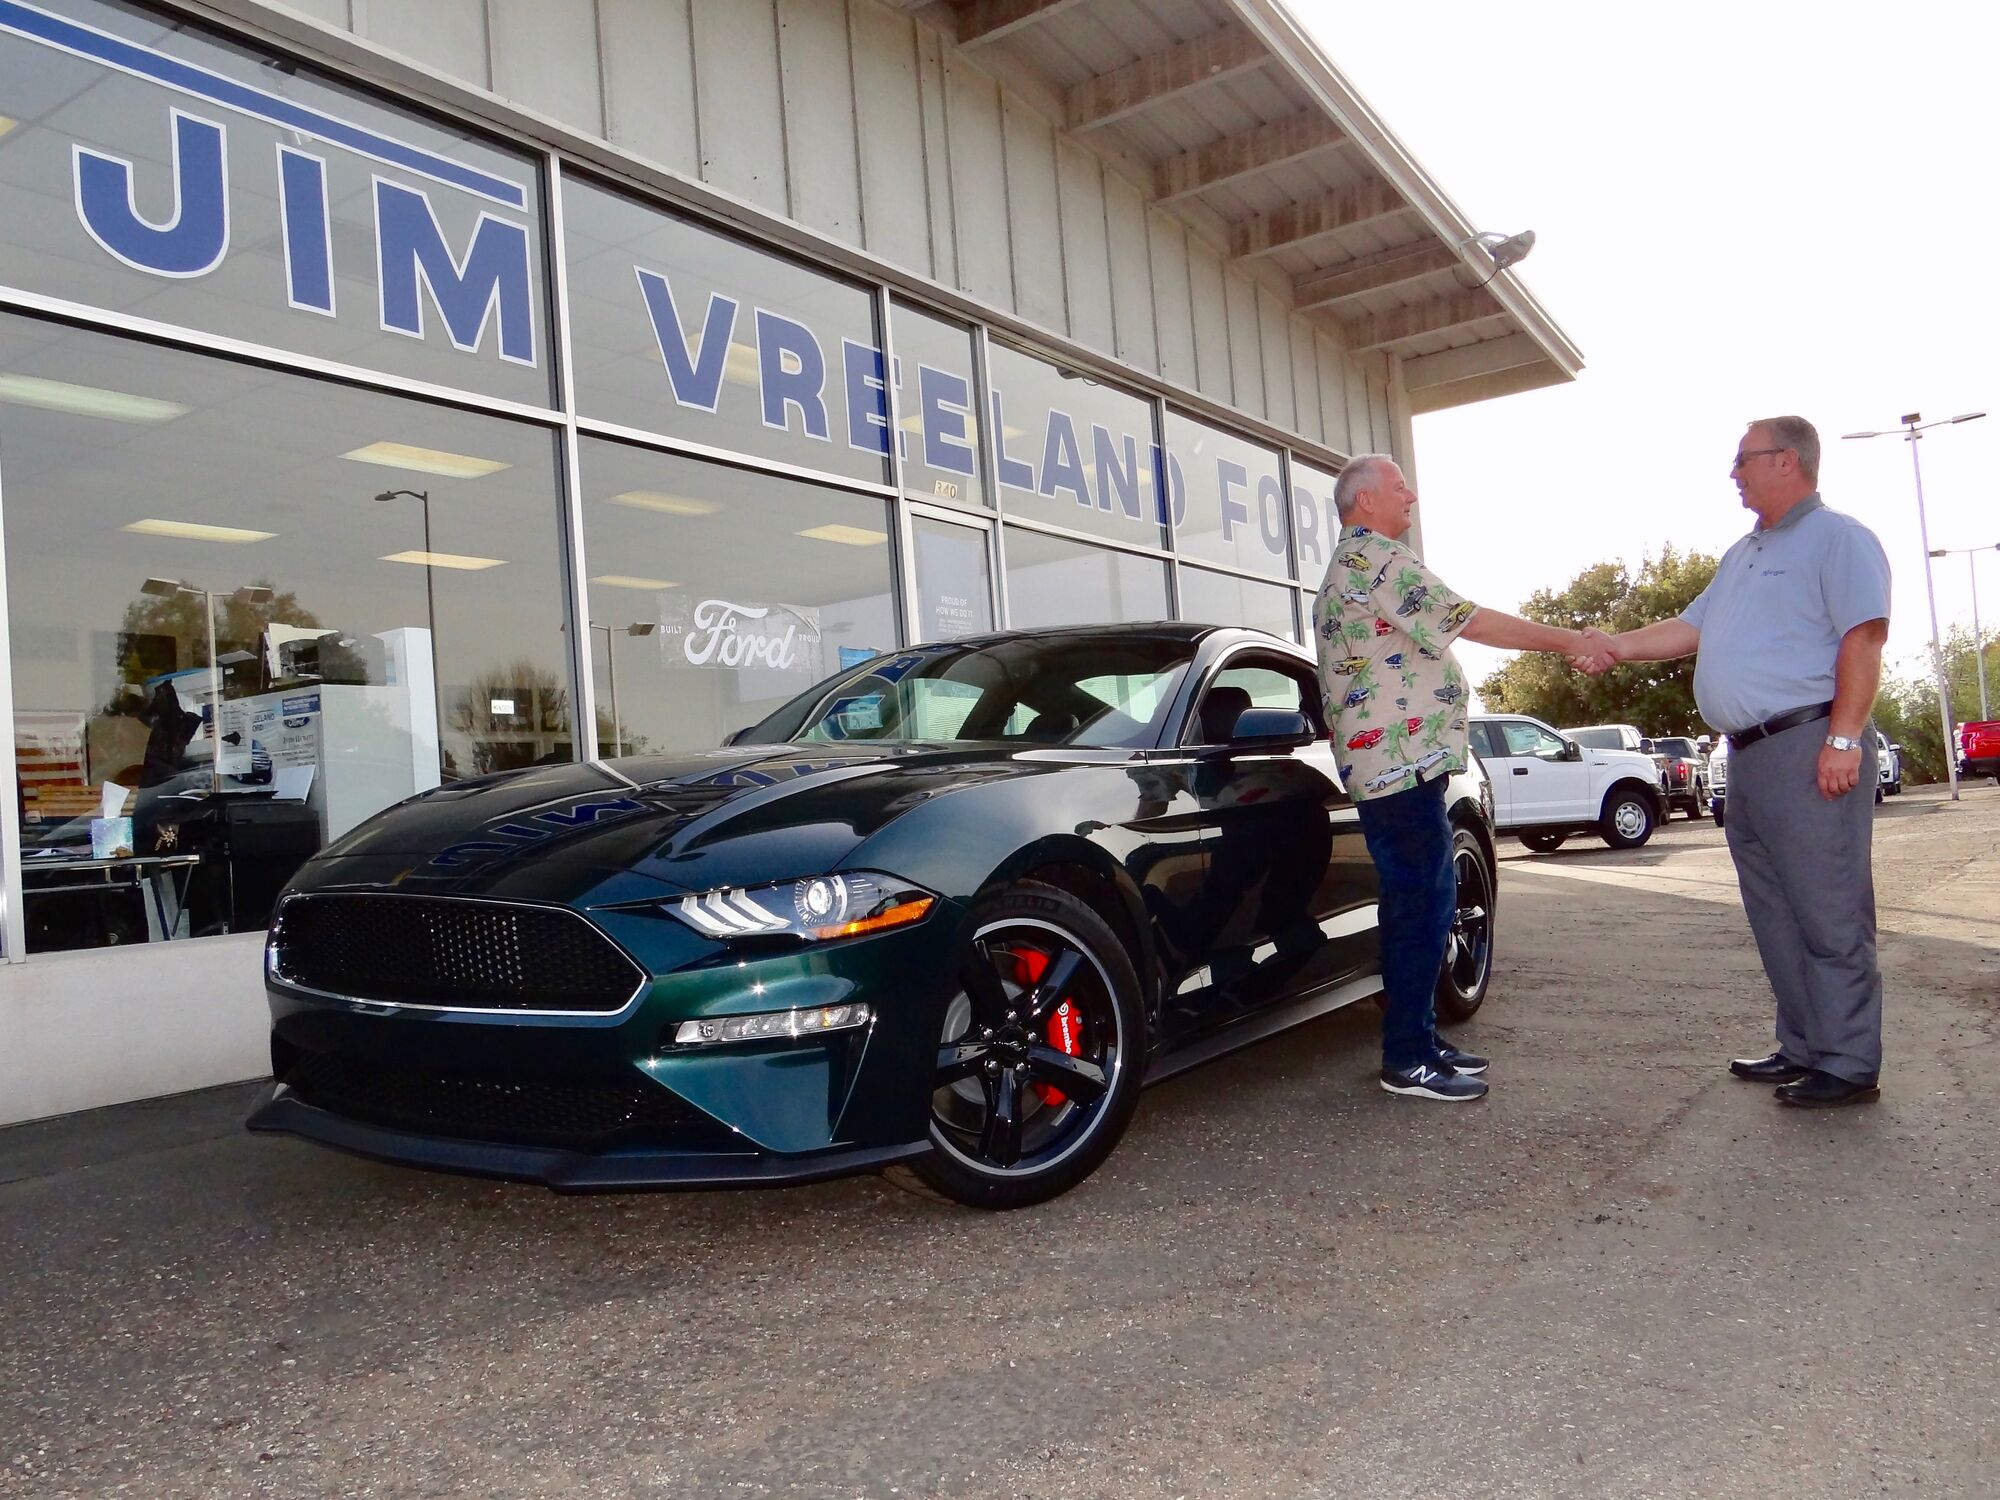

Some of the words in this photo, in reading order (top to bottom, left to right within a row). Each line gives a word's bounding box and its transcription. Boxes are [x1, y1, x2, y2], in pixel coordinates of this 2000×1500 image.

[72, 106, 537, 368] JIM
[633, 265, 1187, 529] VREELAND
[660, 625, 683, 635] BUILT
[684, 599, 796, 670] Ford
[798, 633, 821, 643] PROUD
[1060, 1016, 1073, 1055] brembo
